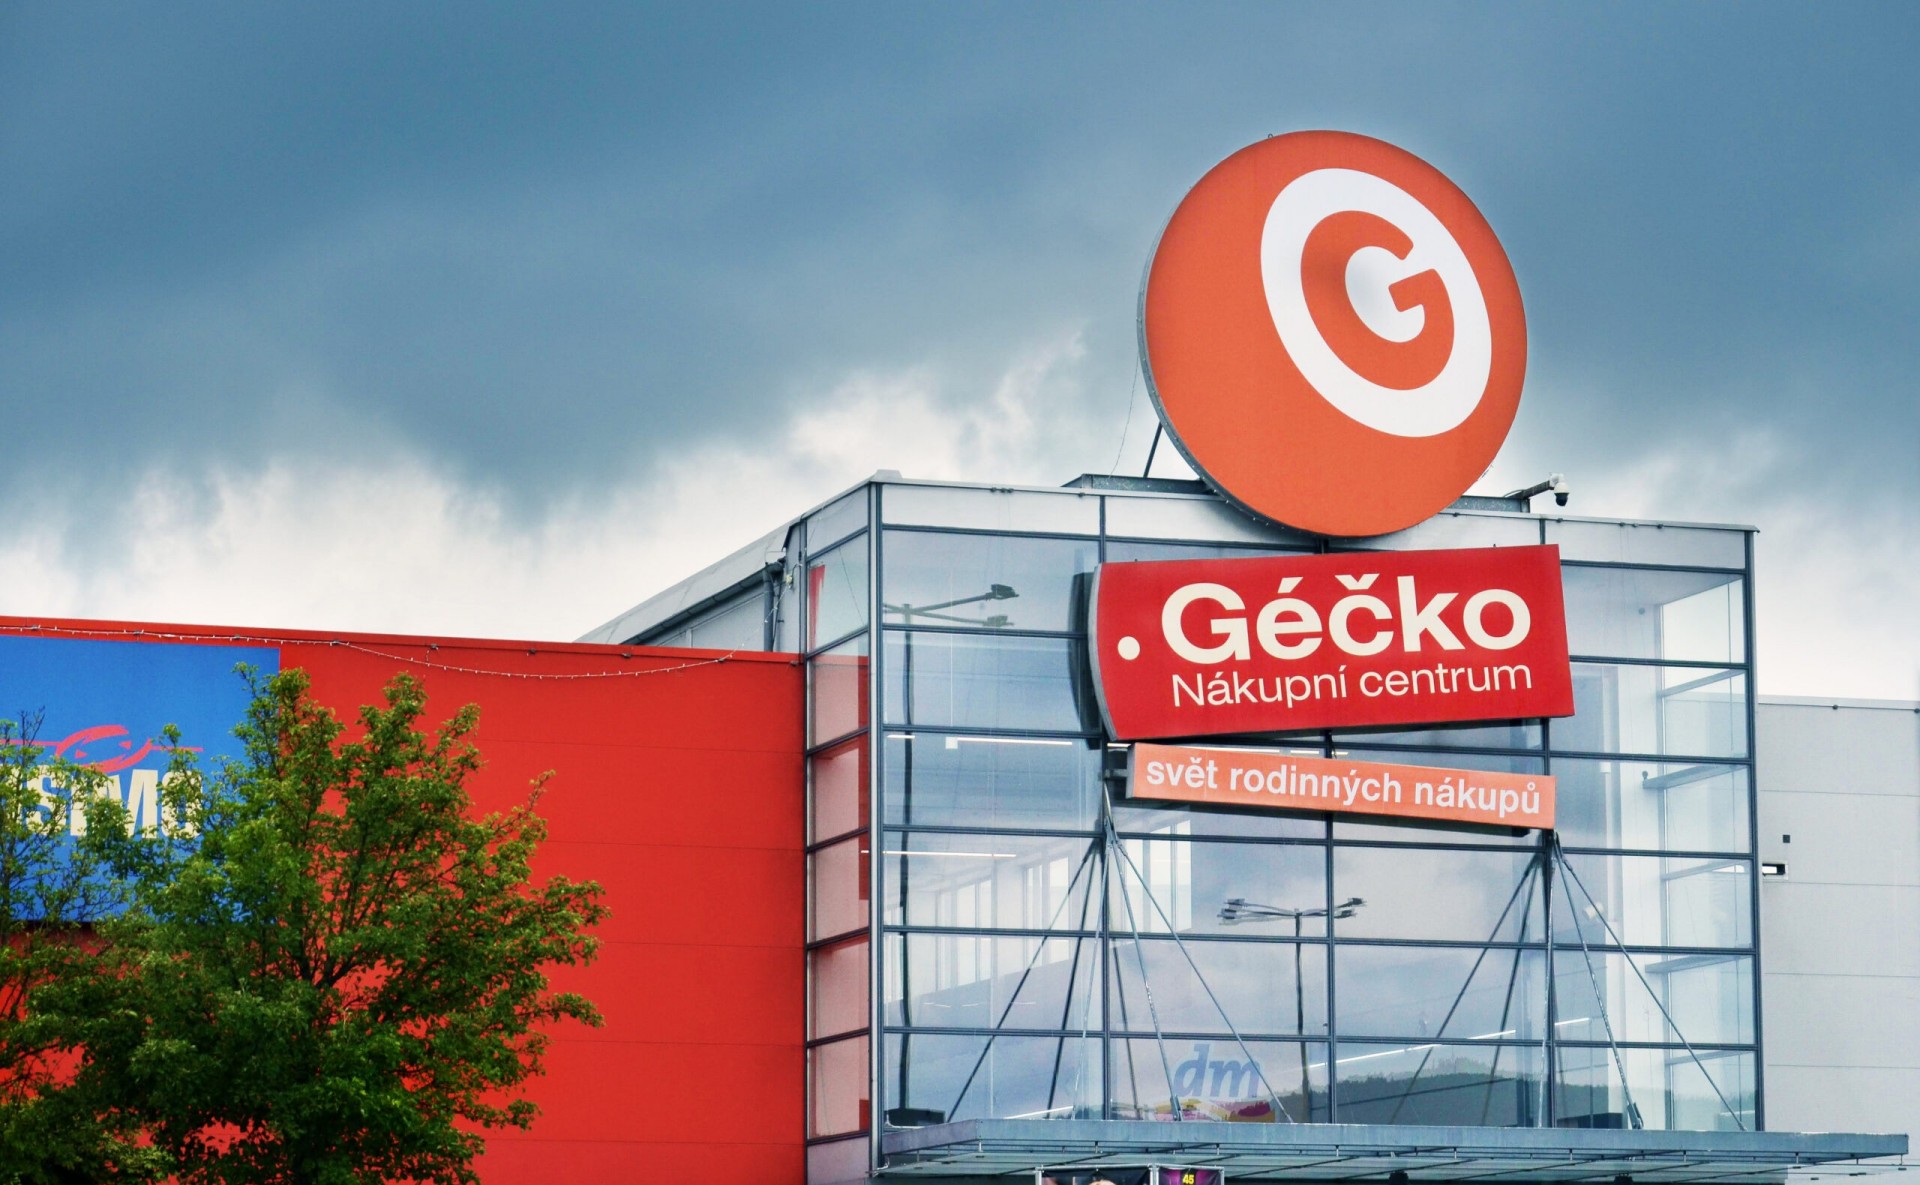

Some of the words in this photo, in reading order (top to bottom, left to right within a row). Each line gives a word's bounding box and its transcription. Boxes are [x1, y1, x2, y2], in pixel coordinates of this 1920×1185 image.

[1161, 574, 1531, 665] Géčko
[1172, 664, 1347, 708] Nákupní
[1359, 662, 1532, 697] centrum
[1146, 757, 1218, 789] svět
[1229, 763, 1402, 807] rodinných
[1414, 778, 1540, 818] nákupů
[1173, 1043, 1262, 1098] dm
